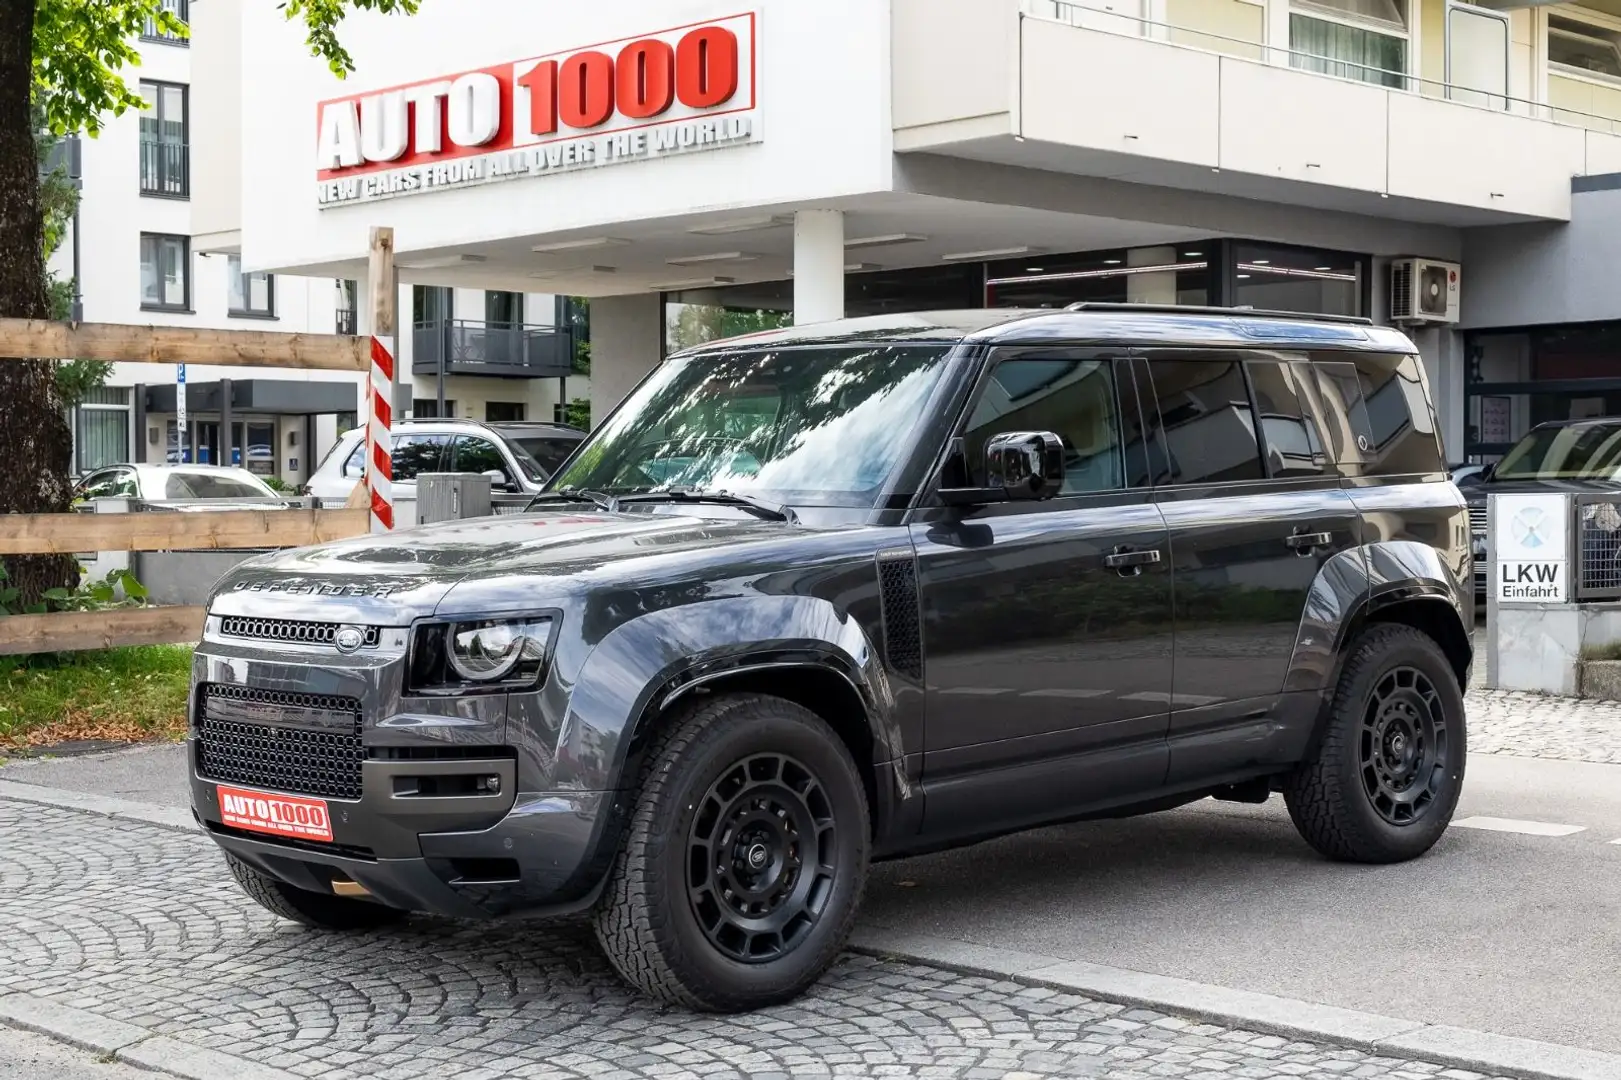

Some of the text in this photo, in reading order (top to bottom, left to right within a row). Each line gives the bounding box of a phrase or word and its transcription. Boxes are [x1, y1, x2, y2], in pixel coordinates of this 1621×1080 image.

[317, 26, 738, 170] AUTO 1000
[317, 117, 750, 203] NEW CARS FROM ALL OVER THE WORLD
[1502, 564, 1558, 583] LKW
[233, 580, 394, 599] DEFENDER
[1502, 585, 1558, 598] Einfahrt
[223, 794, 269, 819] AUTO
[272, 802, 324, 827] 1000
